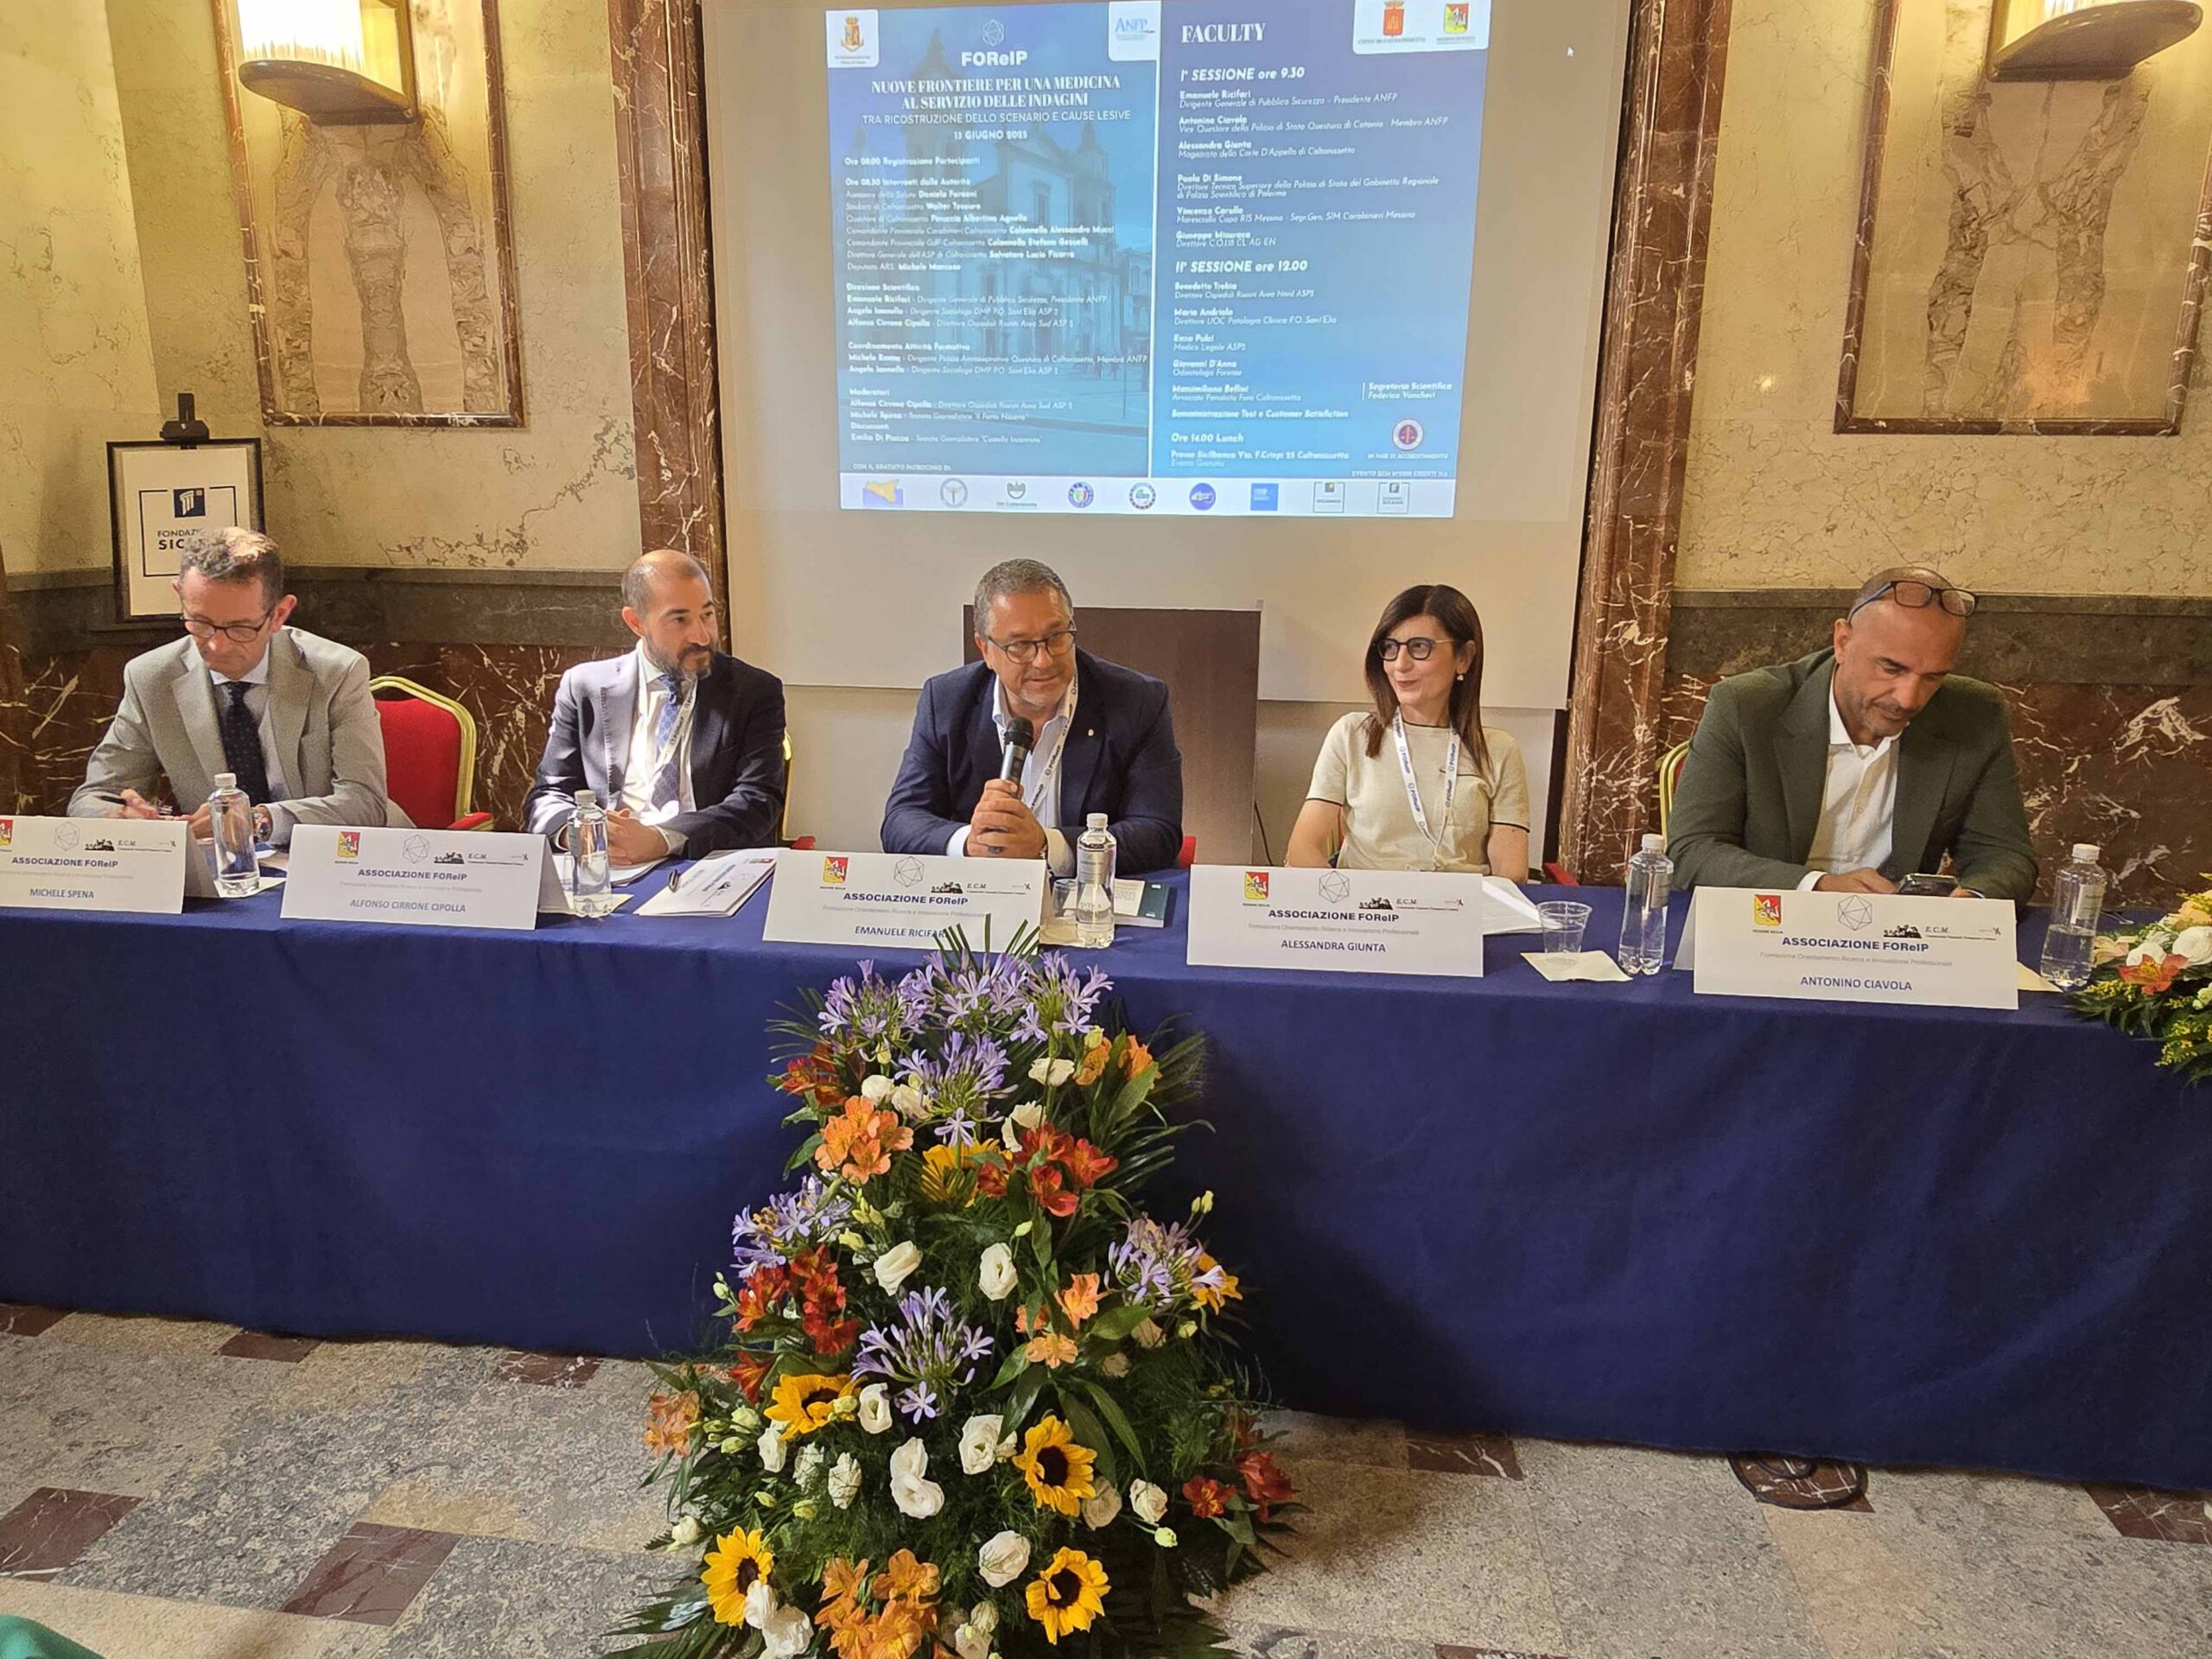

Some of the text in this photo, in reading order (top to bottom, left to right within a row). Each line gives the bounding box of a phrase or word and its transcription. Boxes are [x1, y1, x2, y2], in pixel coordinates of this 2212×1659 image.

[1181, 23, 1266, 42] FACULTY
[961, 51, 1028, 67] FOReIP
[1192, 67, 1306, 82] SESSIONE ore 9.30
[871, 75, 1121, 94] NUOVE FRONTIERE PER UNA MEDICINA
[901, 92, 1088, 110] AL SERVIZIO DELLE INDAGINI
[1179, 99, 1212, 110] Dirigente
[1214, 99, 1247, 108] Generale
[1333, 94, 1371, 105] Presidente
[1373, 92, 1398, 103] ANFP
[862, 109, 1131, 125] TRA RICOSTRUZIONE DELLO SCENARIO E CAUSE LESIVE
[1285, 122, 1305, 131] Stato
[1307, 120, 1342, 130] Questura
[1390, 118, 1422, 127] Membro
[1424, 117, 1448, 126] ANFP
[964, 130, 1004, 140] GIUGNO
[1328, 179, 1347, 188] Stato
[1249, 238, 1262, 246] AG
[1263, 237, 1276, 246] EN
[1190, 259, 1308, 273] SESSIONE ore 12.00
[1207, 316, 1225, 325] UOC
[12, 856, 118, 868] ASSOCIAZIONE FOReIP
[358, 868, 467, 880] ASSOCIAZIONE FOReIP
[29, 887, 95, 899] MICHELE SPENA
[842, 893, 969, 906] ASSOCIAZIONE FOReIP
[350, 899, 467, 912] ALFONSO CIRRONE CIPOLLA
[1268, 909, 1400, 922] ASSOCIAZIONE FOReIP
[855, 925, 947, 938] EMANUELE RICIFAR
[1281, 939, 1386, 952] ALESSANDRA GIUNTA
[1782, 937, 1929, 952] ASSOCIAZIONE FOReIP
[1800, 976, 1912, 990] ANTONINO CIAVOLA
